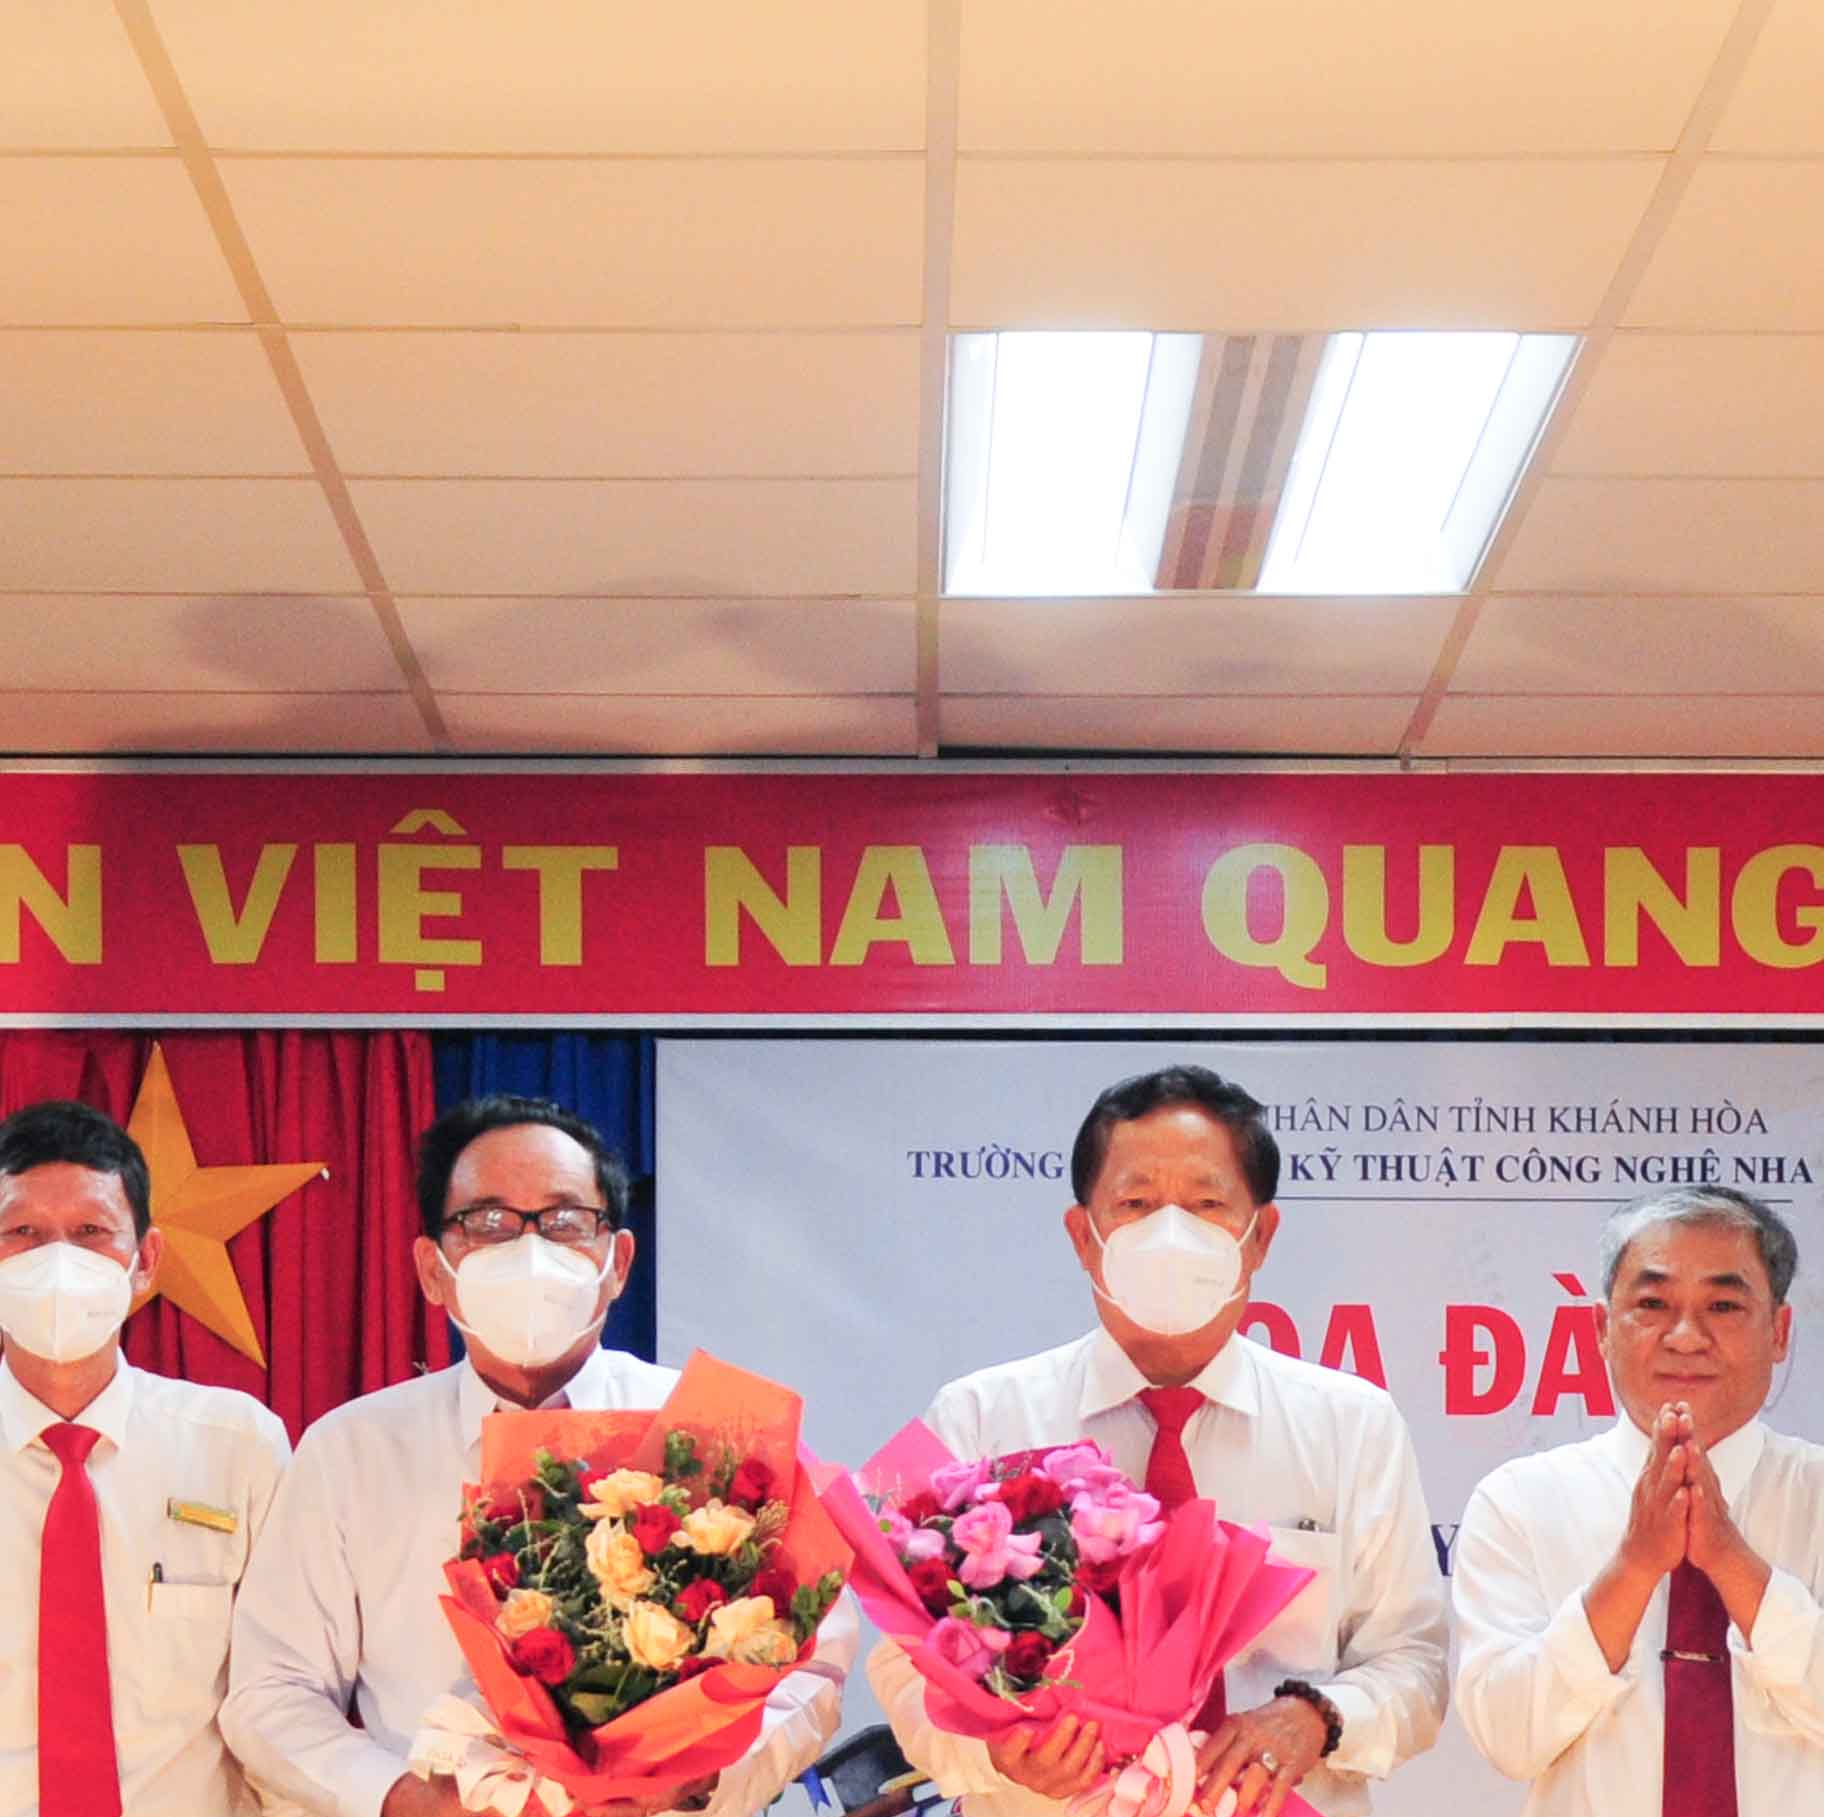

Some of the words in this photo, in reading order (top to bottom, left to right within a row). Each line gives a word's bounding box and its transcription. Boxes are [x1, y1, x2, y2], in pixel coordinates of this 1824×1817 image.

[179, 807, 619, 991] VIỆT
[703, 844, 1124, 966] NAM
[1363, 1097, 1440, 1132] DÂN
[1450, 1097, 1536, 1134] TỈNH
[1549, 1098, 1679, 1134] KHÁNH
[1690, 1098, 1768, 1135] HÒA
[906, 1142, 1065, 1180] TRƯỜNG
[1288, 1146, 1342, 1181] KỸ
[1353, 1146, 1484, 1187] THUẬT
[1495, 1146, 1600, 1183] CÔNG
[1732, 1156, 1814, 1184] NHA
[1439, 1273, 1616, 1416] ĐÀ
